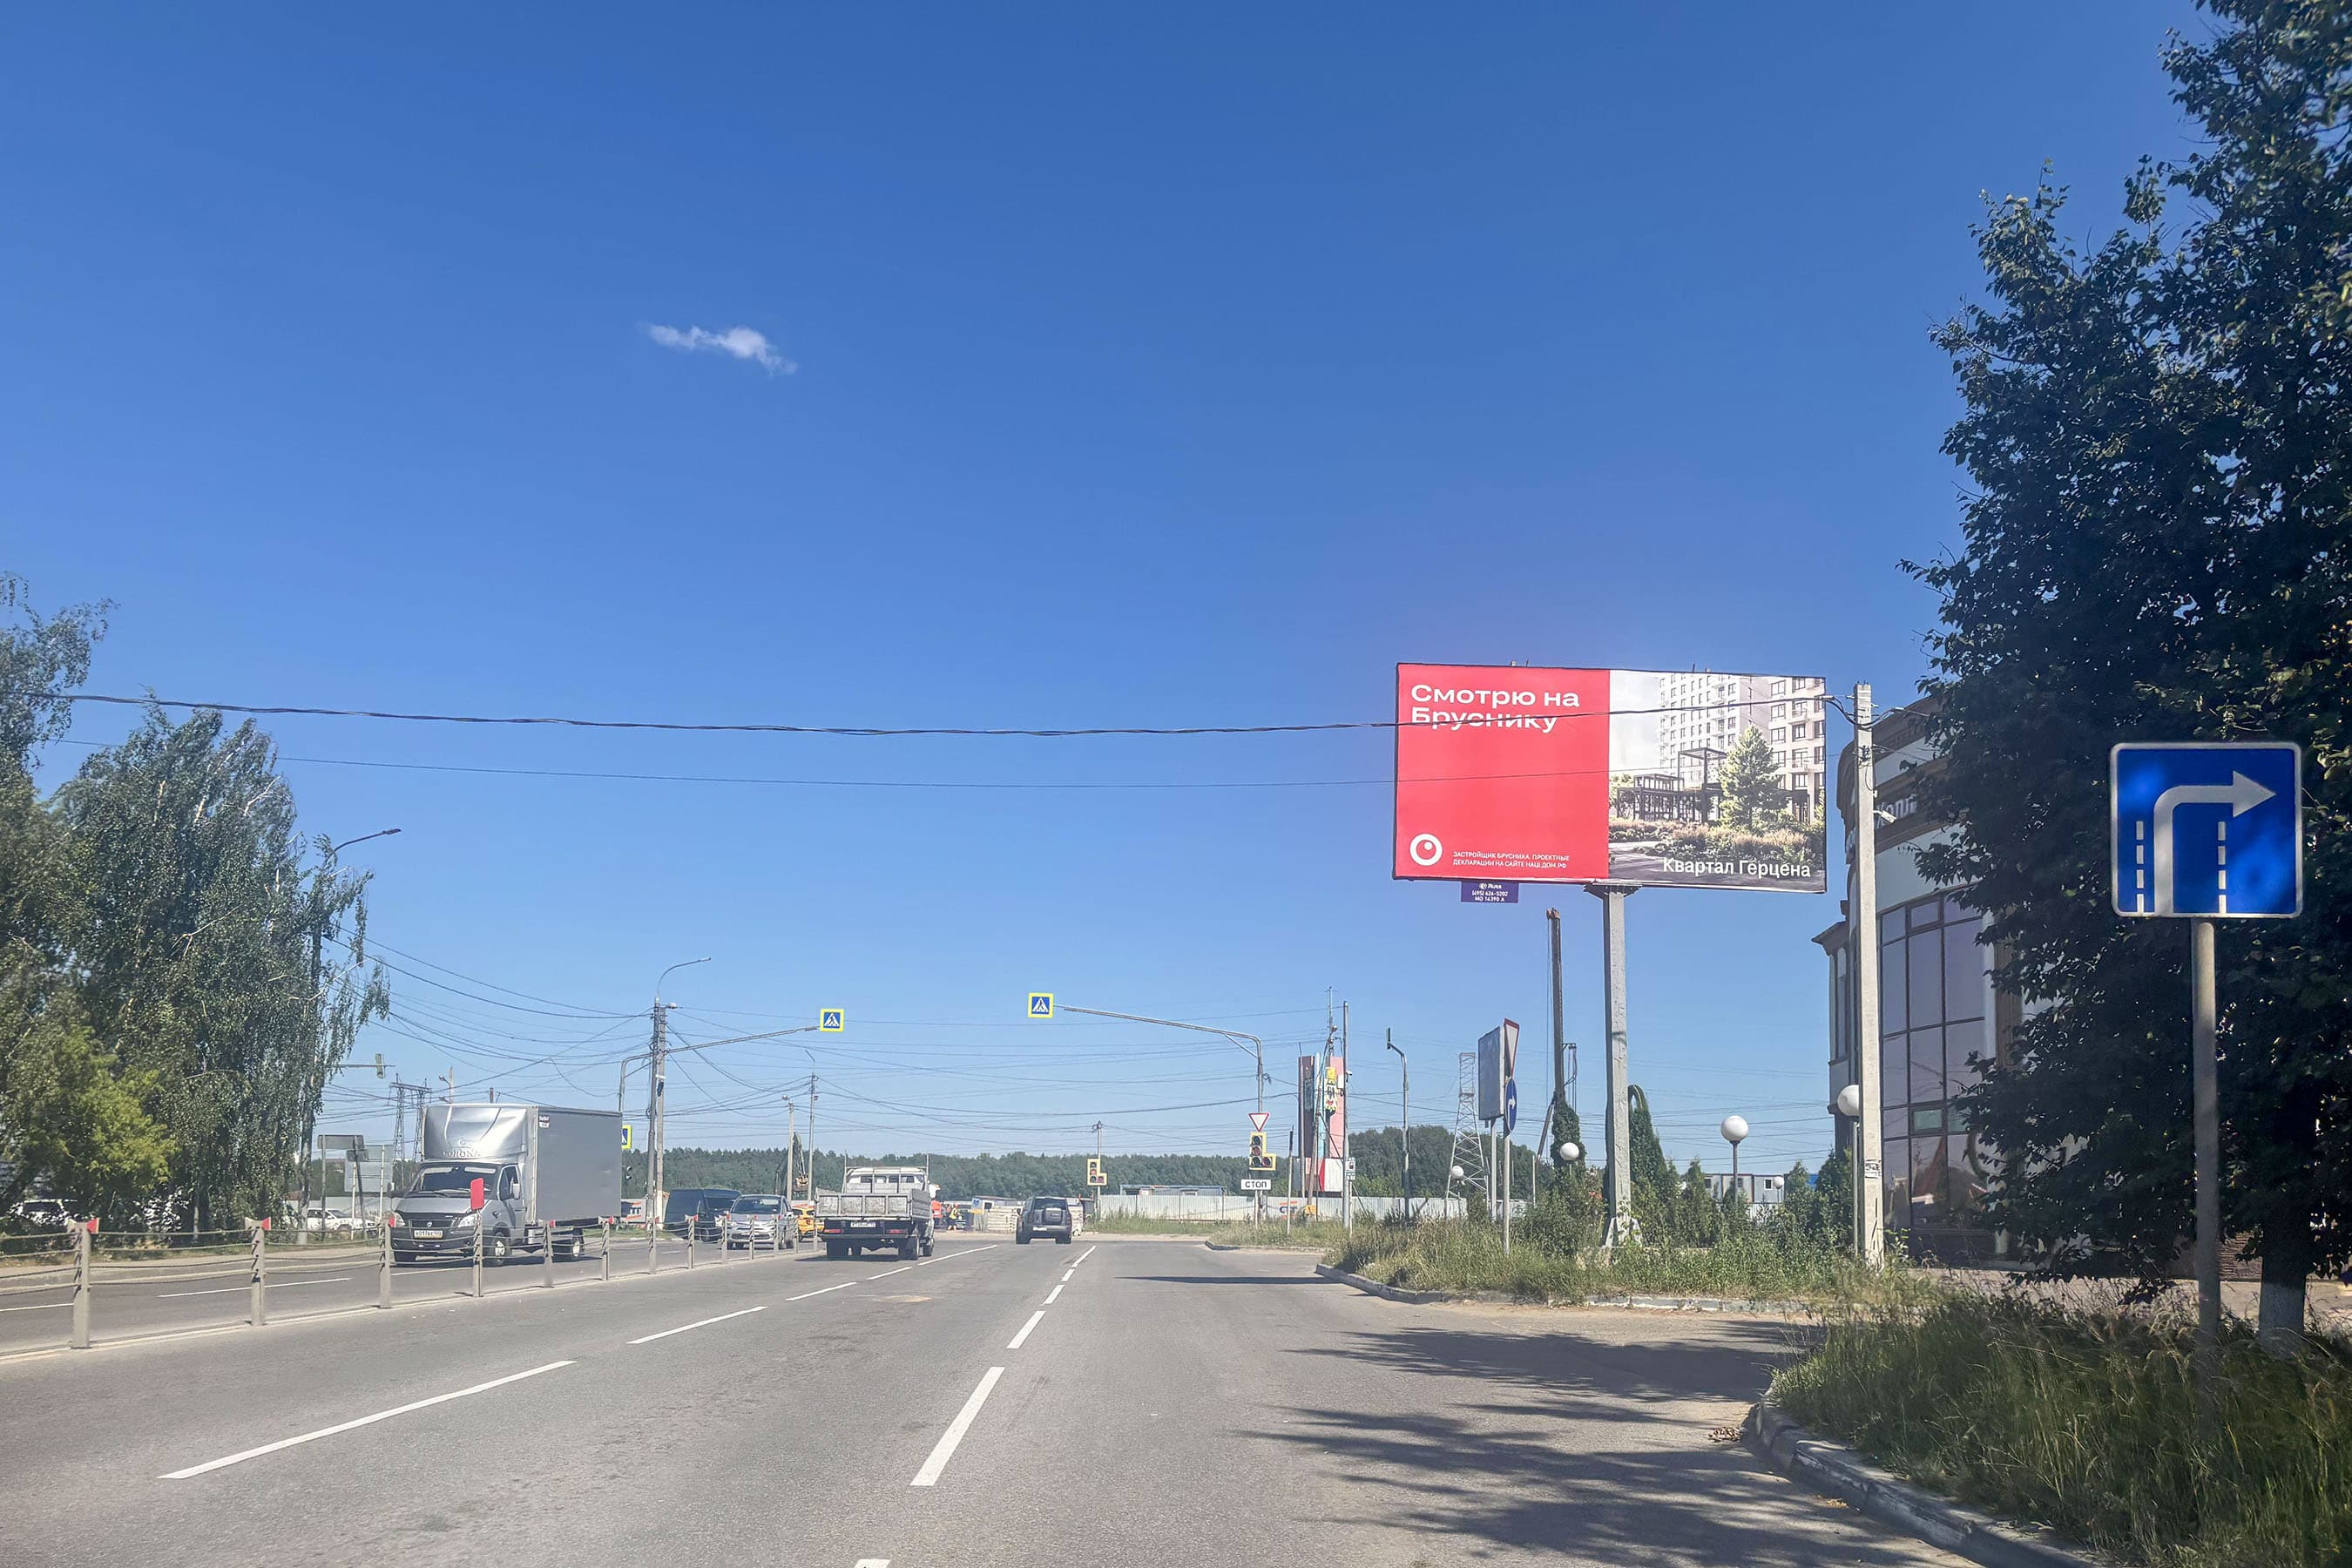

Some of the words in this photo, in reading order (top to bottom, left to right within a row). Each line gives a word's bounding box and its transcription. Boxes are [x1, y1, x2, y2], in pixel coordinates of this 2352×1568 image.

[1411, 684, 1536, 709] Смотрю
[1544, 692, 1580, 707] на
[1411, 706, 1558, 733] Бруснику
[1663, 857, 1734, 876] Квартал
[1739, 860, 1811, 879] Герцена
[1245, 1180, 1267, 1189] СТОП
